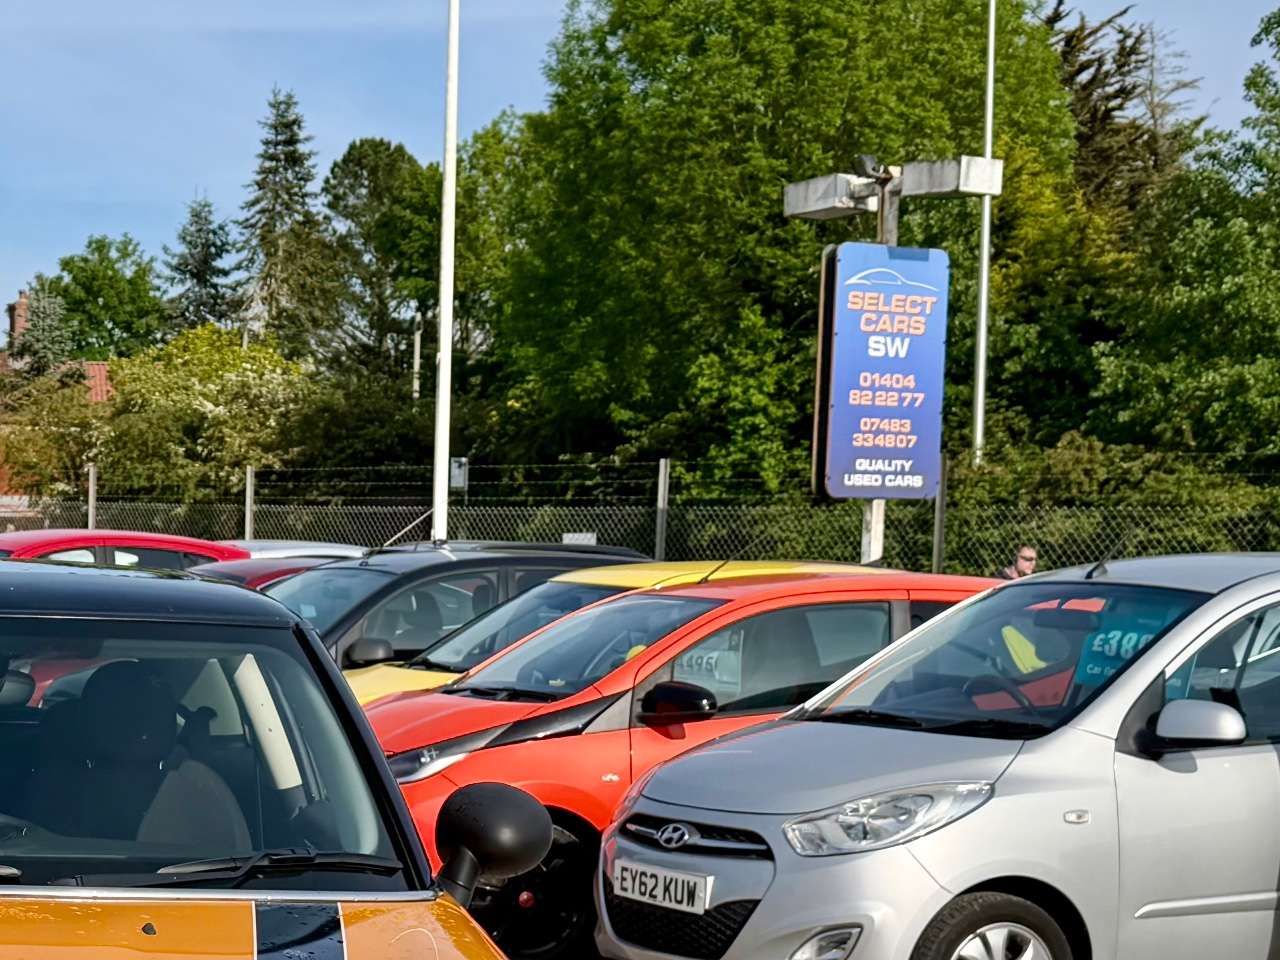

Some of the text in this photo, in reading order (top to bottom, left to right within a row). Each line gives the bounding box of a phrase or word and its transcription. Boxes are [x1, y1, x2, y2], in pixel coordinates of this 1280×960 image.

[847, 291, 937, 315] SELECT
[860, 312, 926, 336] CARS
[867, 335, 910, 358] SW
[860, 372, 916, 389] 01404
[860, 417, 911, 433] 07483
[852, 433, 918, 448] 334807
[855, 458, 913, 472] QUALITY
[843, 474, 923, 487] USED CARS
[620, 866, 697, 908] EY62 KUW
